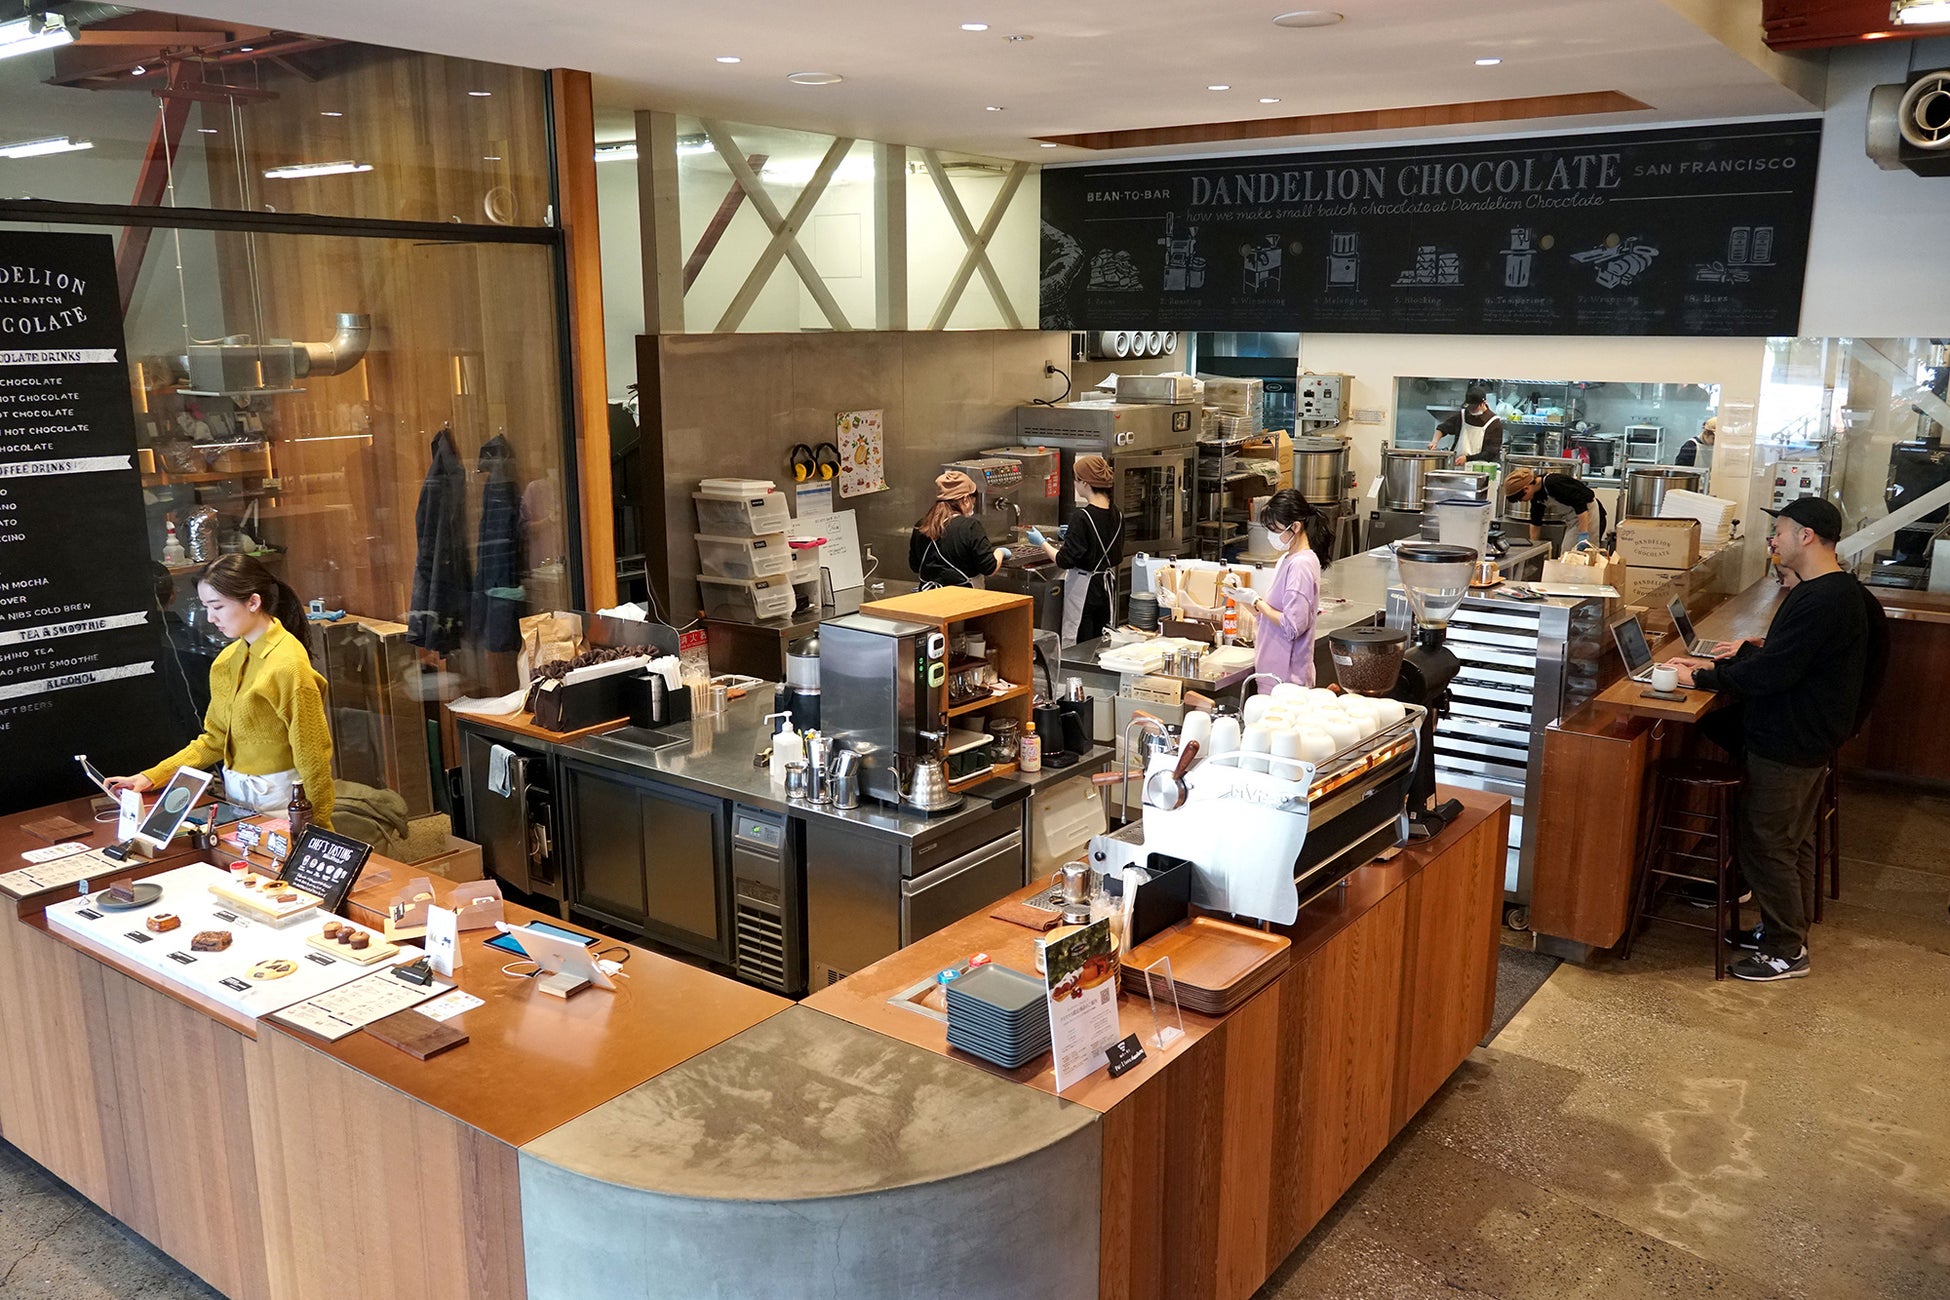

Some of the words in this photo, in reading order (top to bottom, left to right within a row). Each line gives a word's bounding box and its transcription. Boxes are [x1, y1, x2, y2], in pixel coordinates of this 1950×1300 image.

[1634, 164, 1672, 176] SAN
[1680, 157, 1796, 174] FRANCISCO
[1190, 167, 1385, 206] DANDELION
[1398, 154, 1621, 196] CHOCOLATE
[1186, 208, 1212, 222] how
[1216, 211, 1234, 221] we
[1236, 207, 1272, 220] make
[1361, 200, 1432, 215] chocolate
[1433, 200, 1448, 213] at
[1451, 195, 1522, 211] Dandelion
[1526, 191, 1605, 209] Chocolate
[41, 351, 81, 362] DRINKS
[19, 392, 80, 402] CHOCOLATE
[12, 408, 74, 418] CHOCOLATE
[4, 427, 25, 436] HOT
[29, 424, 90, 435] CHOCOLATE
[32, 461, 72, 474] DRINKS
[1634, 538, 1671, 548] DANDELION
[1633, 549, 1670, 558] CHOCOLATE
[12, 577, 50, 589] MOCHA
[8, 610, 32, 620] NIBS
[34, 606, 61, 616] COLD
[63, 602, 92, 612] BREW
[20, 629, 40, 641] TEA
[42, 627, 51, 637] &
[53, 619, 107, 637] SMOOTHIE
[34, 647, 55, 656] TEA
[16, 662, 46, 673] FRUIT
[49, 653, 100, 669] SMOOTHIE
[46, 672, 97, 690] ALCOHOL
[20, 700, 54, 713] BEERS
[308, 838, 331, 854] CHEF'S
[328, 843, 354, 861] TASTING
